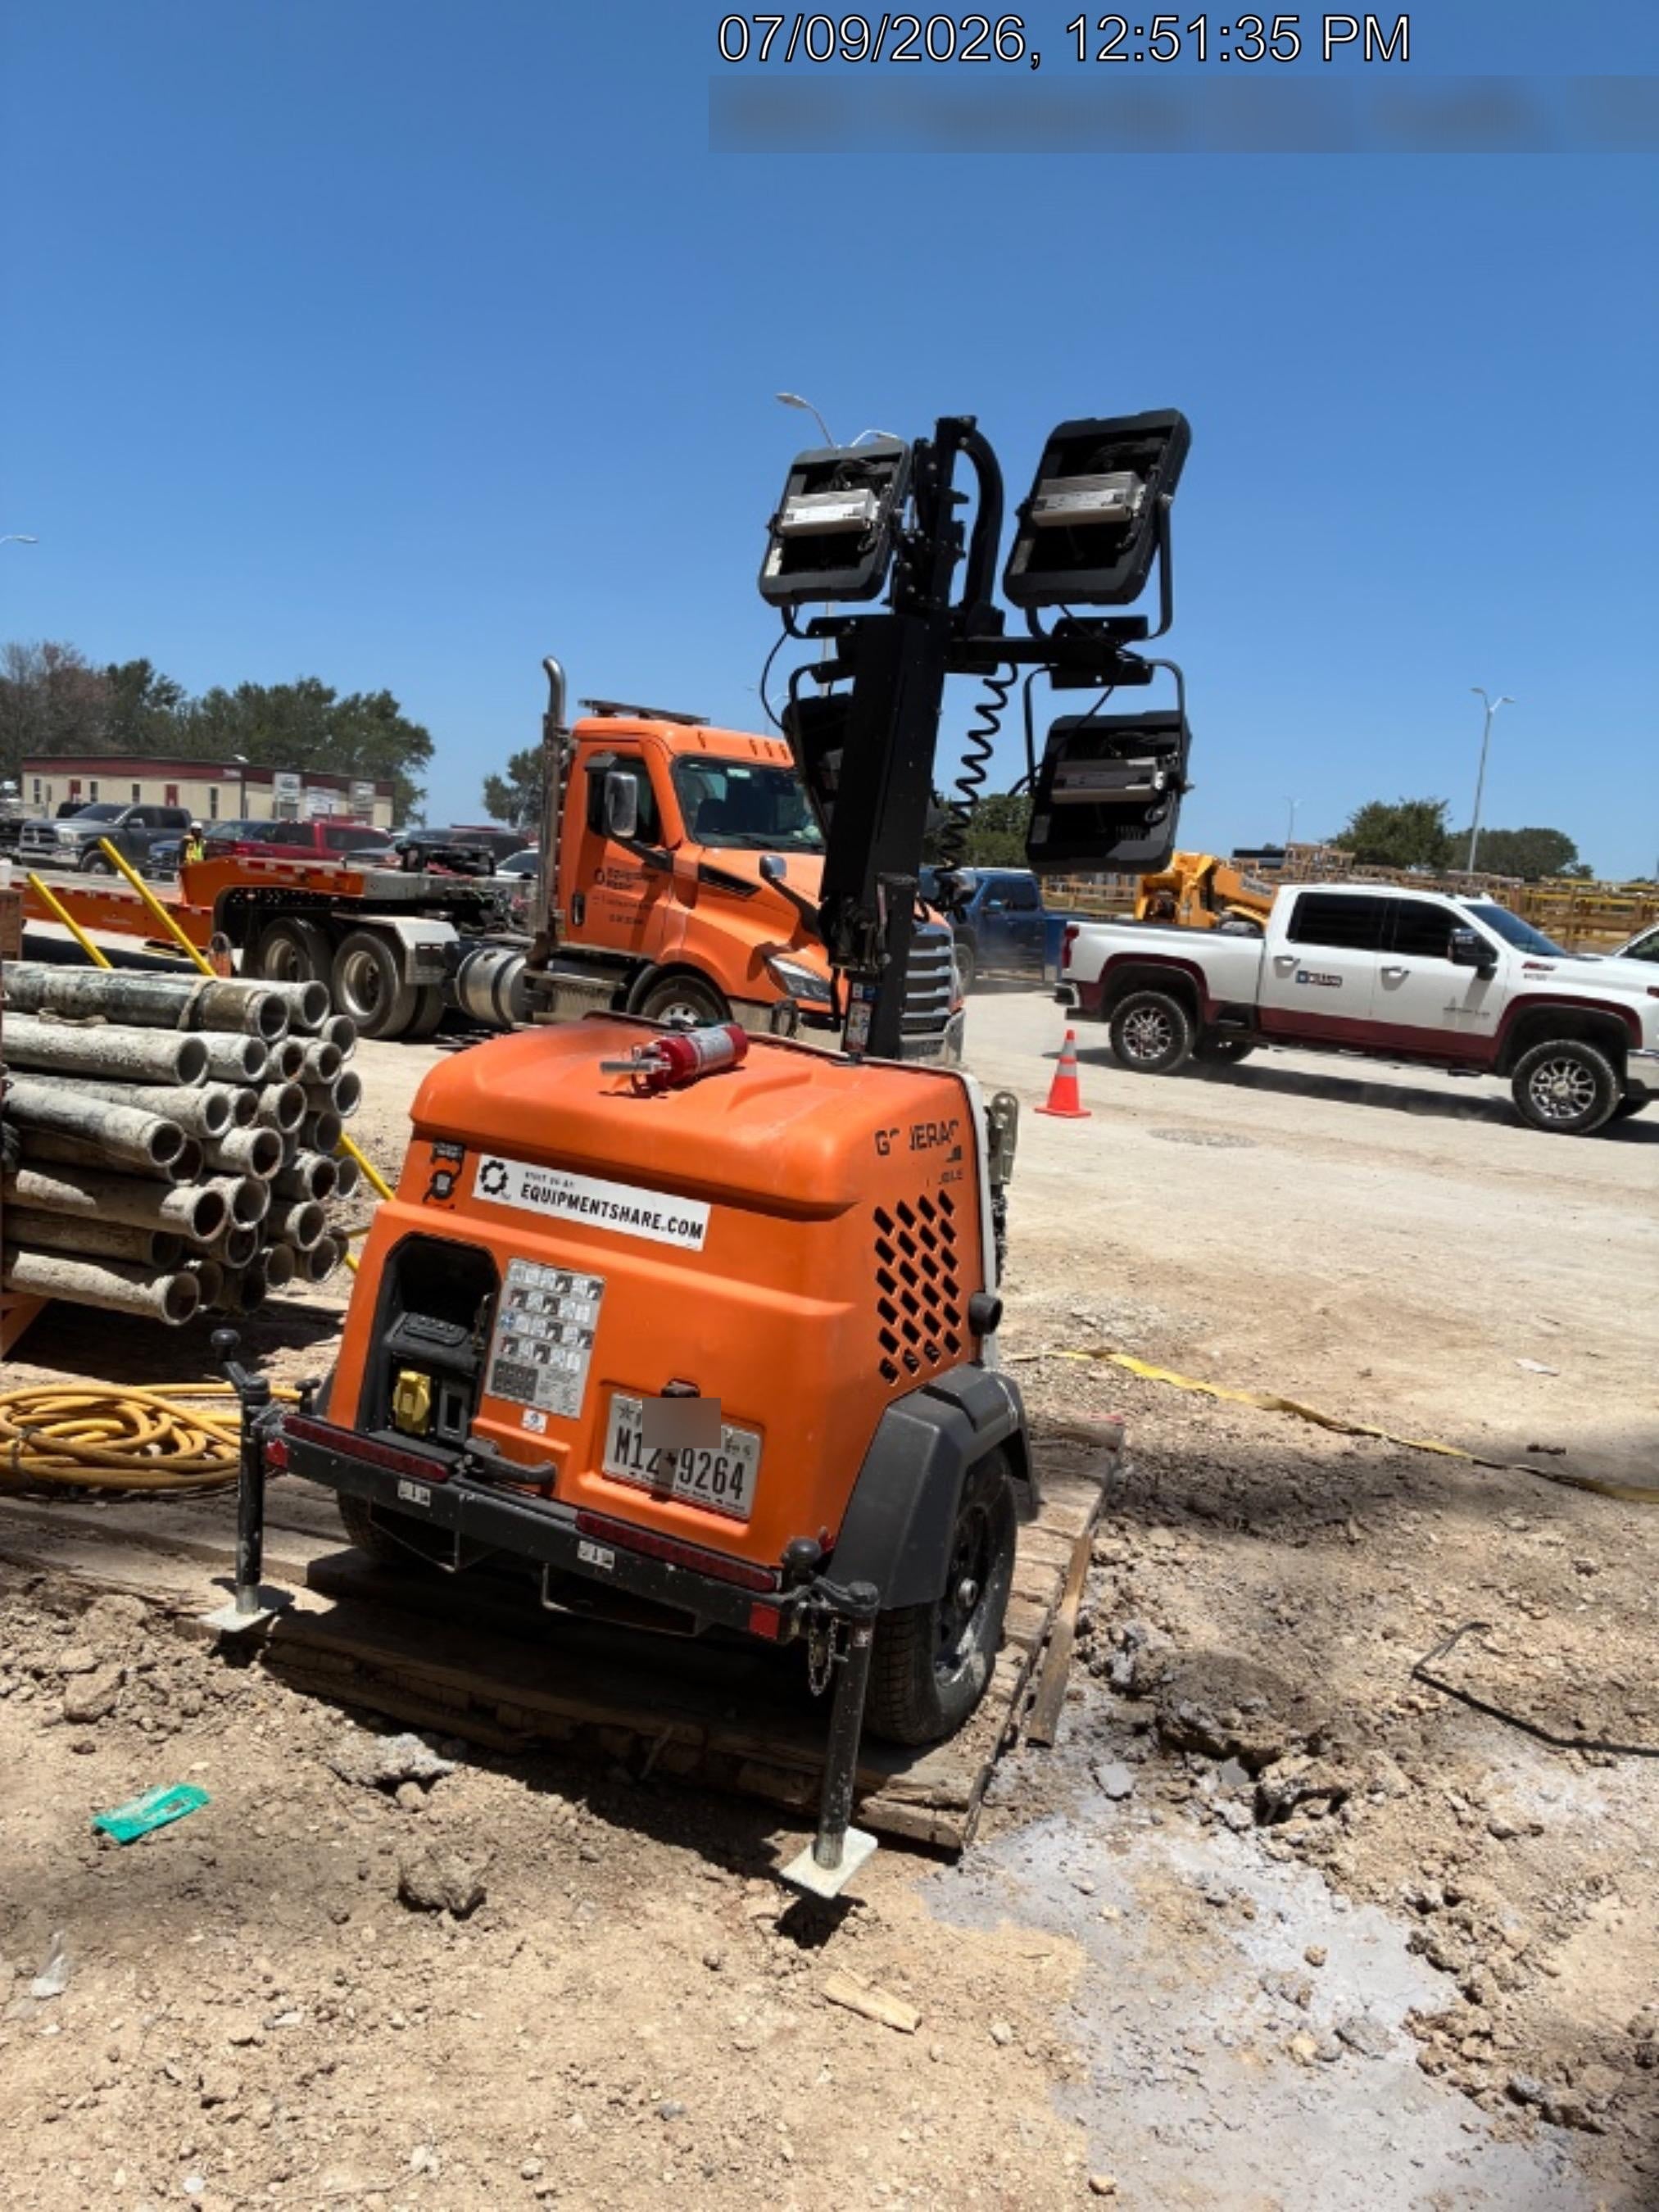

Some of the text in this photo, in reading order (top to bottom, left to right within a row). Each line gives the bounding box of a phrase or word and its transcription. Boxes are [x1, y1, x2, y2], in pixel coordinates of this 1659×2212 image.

[874, 1119, 959, 1156] GERA
[520, 1183, 704, 1240] EQUIPMENTSHARE.COM
[678, 1446, 746, 1500] 9264
